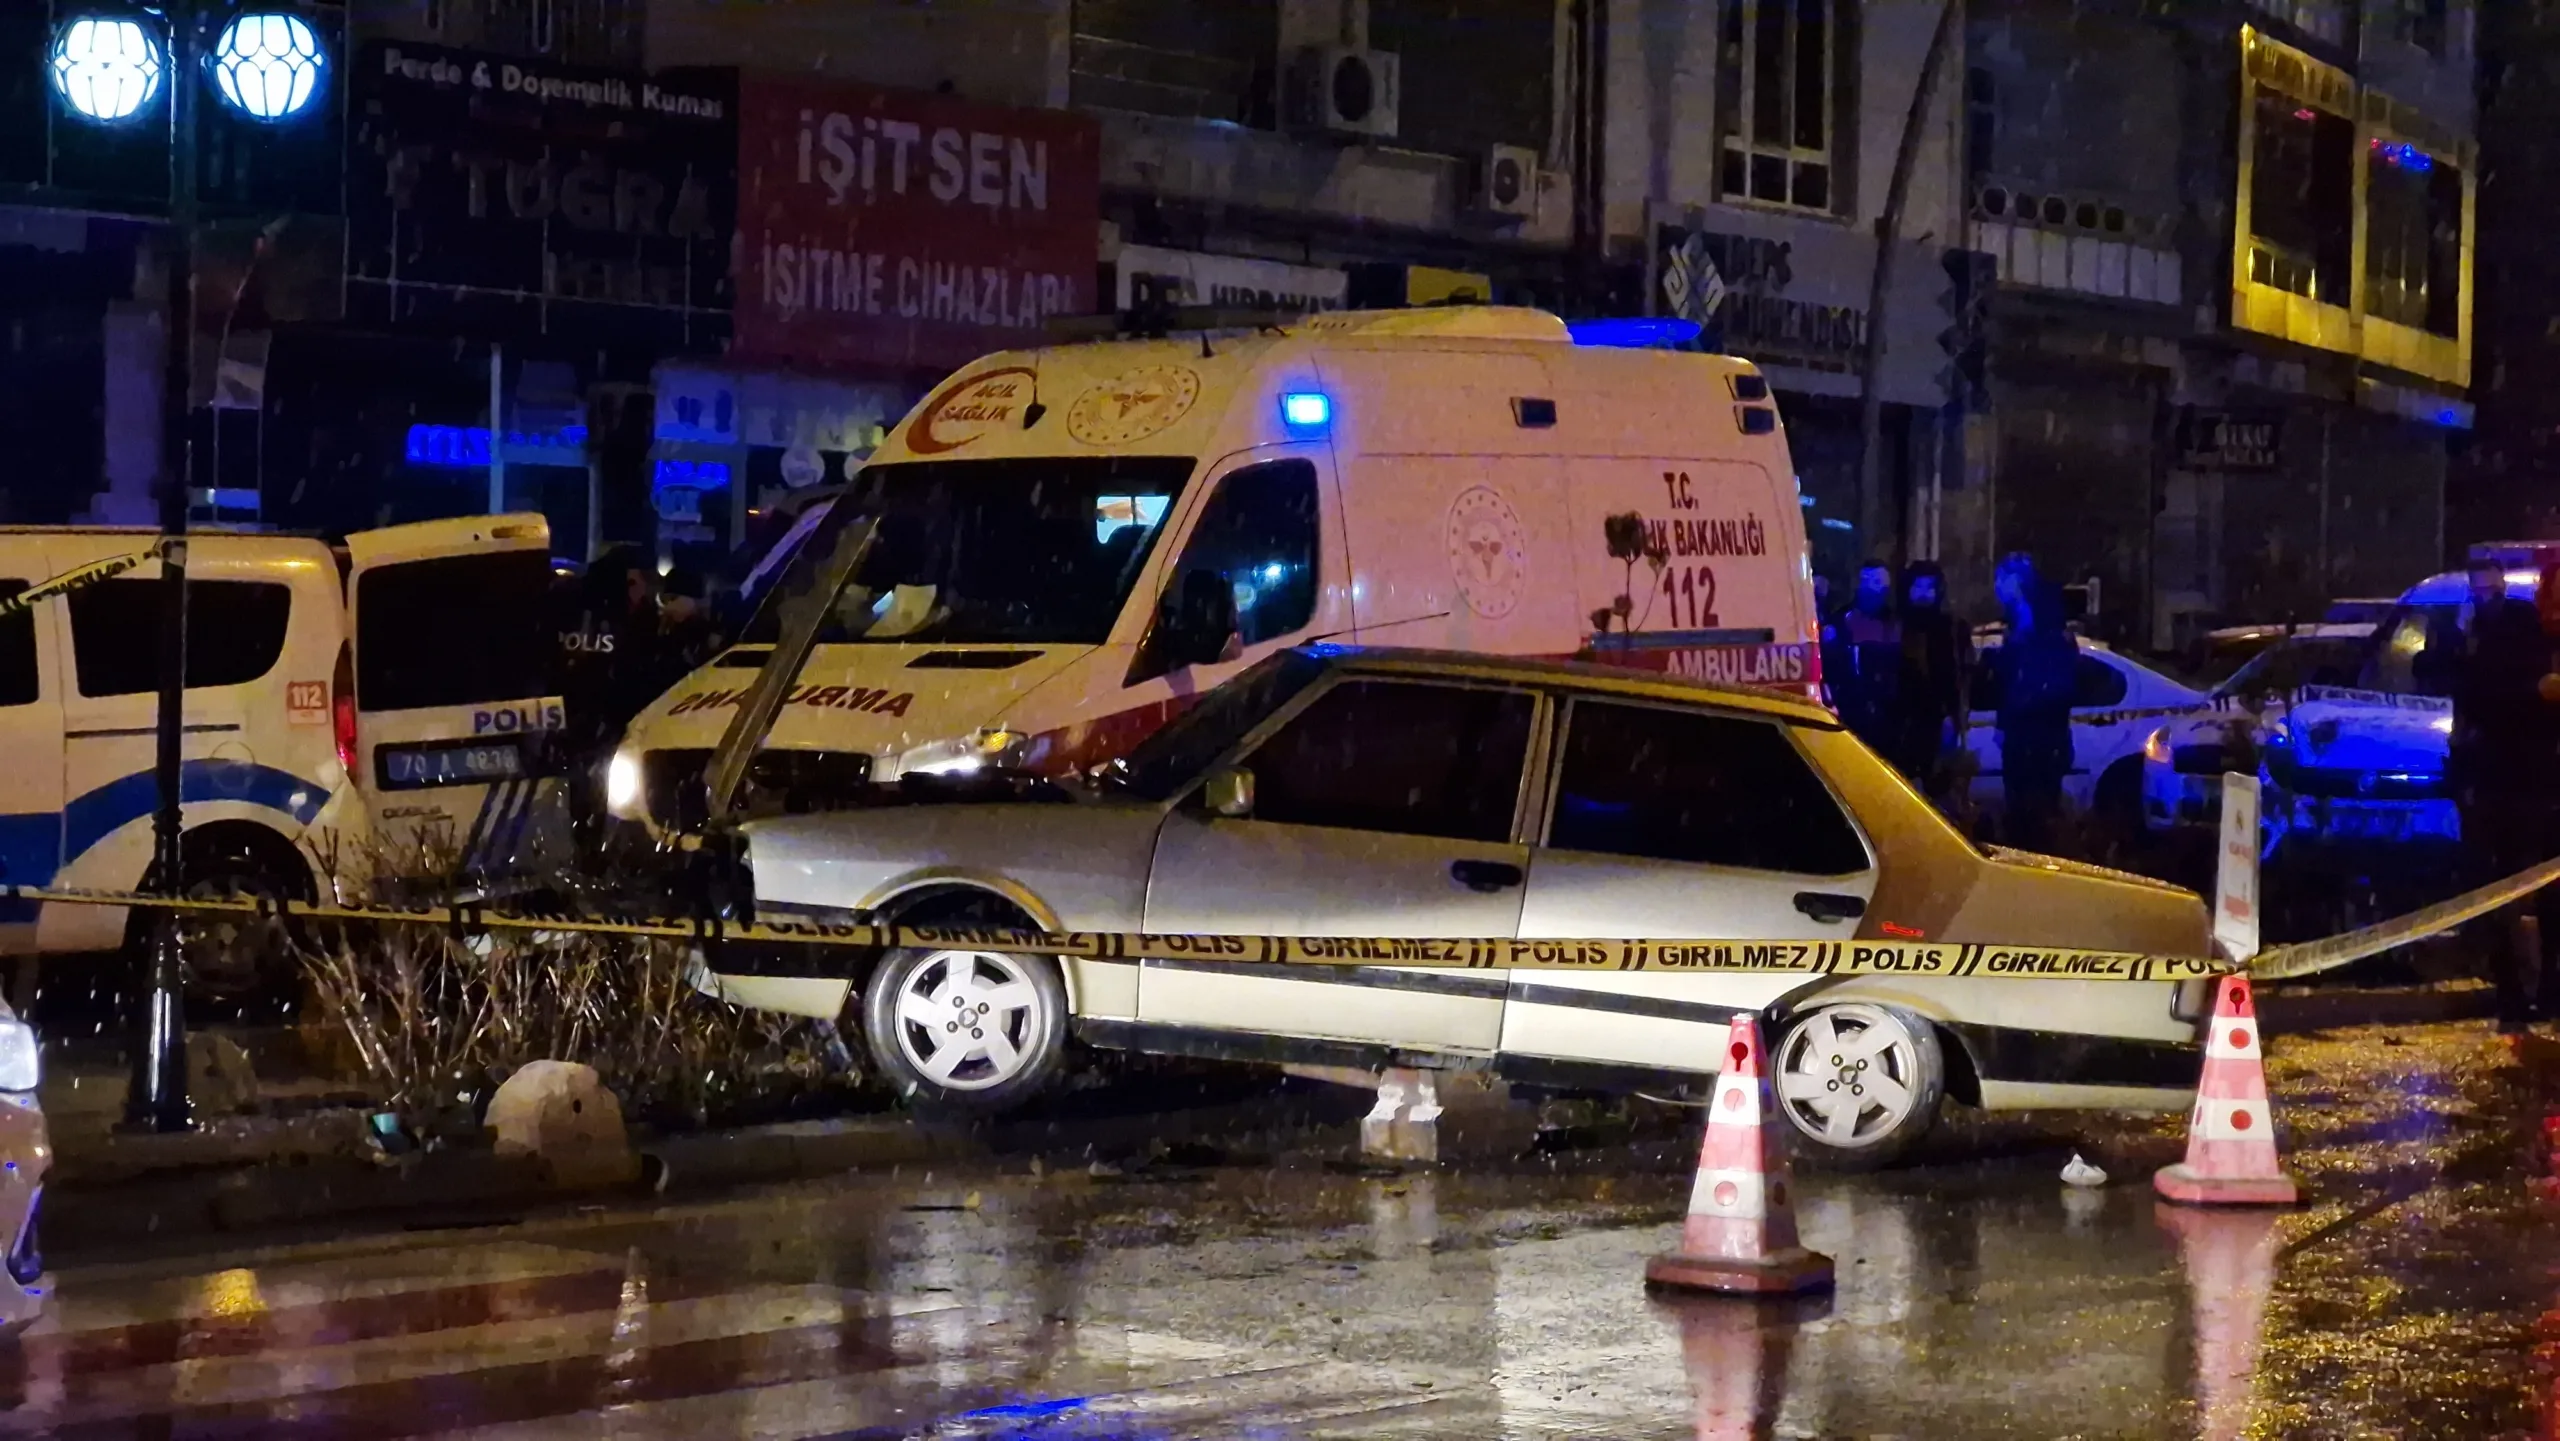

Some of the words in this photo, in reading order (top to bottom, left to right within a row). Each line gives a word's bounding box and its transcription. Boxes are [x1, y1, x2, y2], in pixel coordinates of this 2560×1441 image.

[1674, 512, 1767, 556] BAKANLIĞI
[1663, 566, 1719, 628] 112
[1667, 646, 1802, 682] AMBULANS
[291, 685, 323, 707] 112
